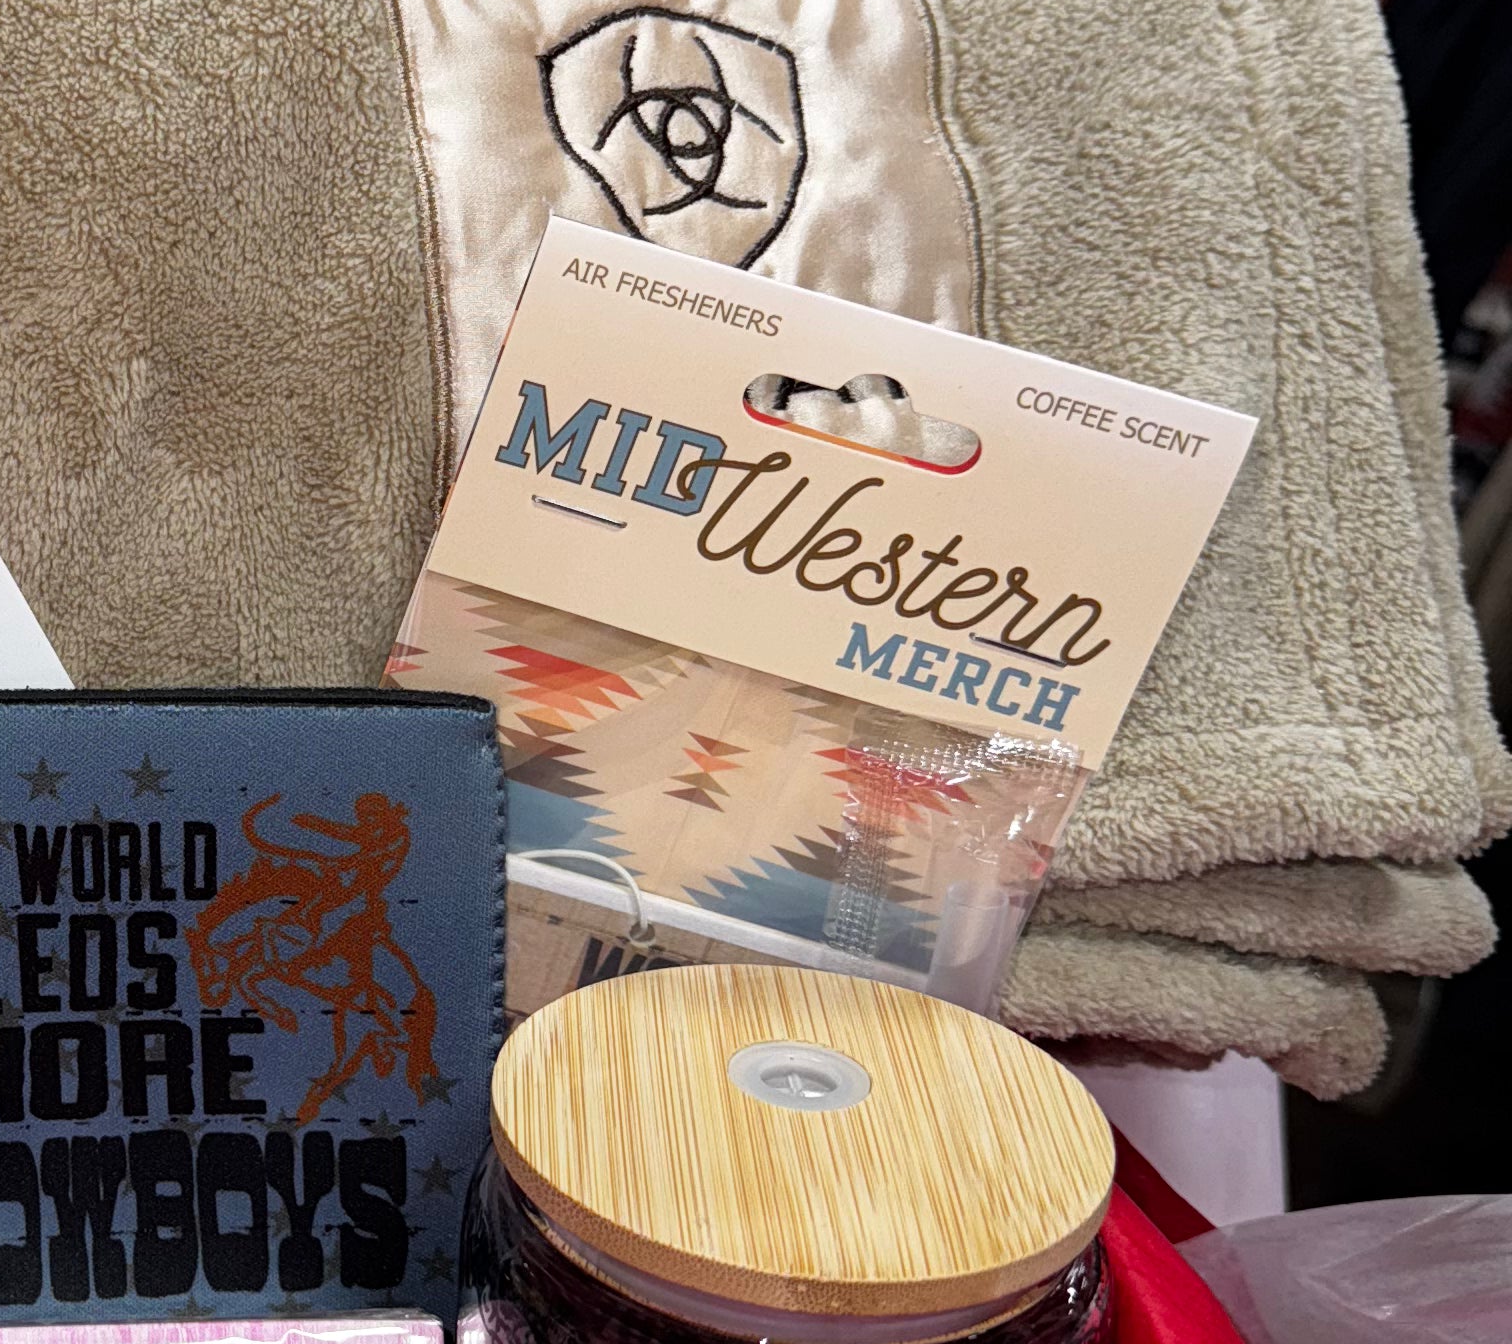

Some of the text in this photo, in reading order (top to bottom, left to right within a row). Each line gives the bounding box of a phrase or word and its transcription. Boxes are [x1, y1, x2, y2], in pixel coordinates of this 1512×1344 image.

[562, 258, 783, 337] AIR FRESHENERS
[494, 379, 728, 517] MID
[1016, 386, 1210, 458] COFFEE SCENT
[677, 451, 1111, 667] Western
[835, 622, 1082, 733] MERCH
[12, 820, 218, 906] WORLD
